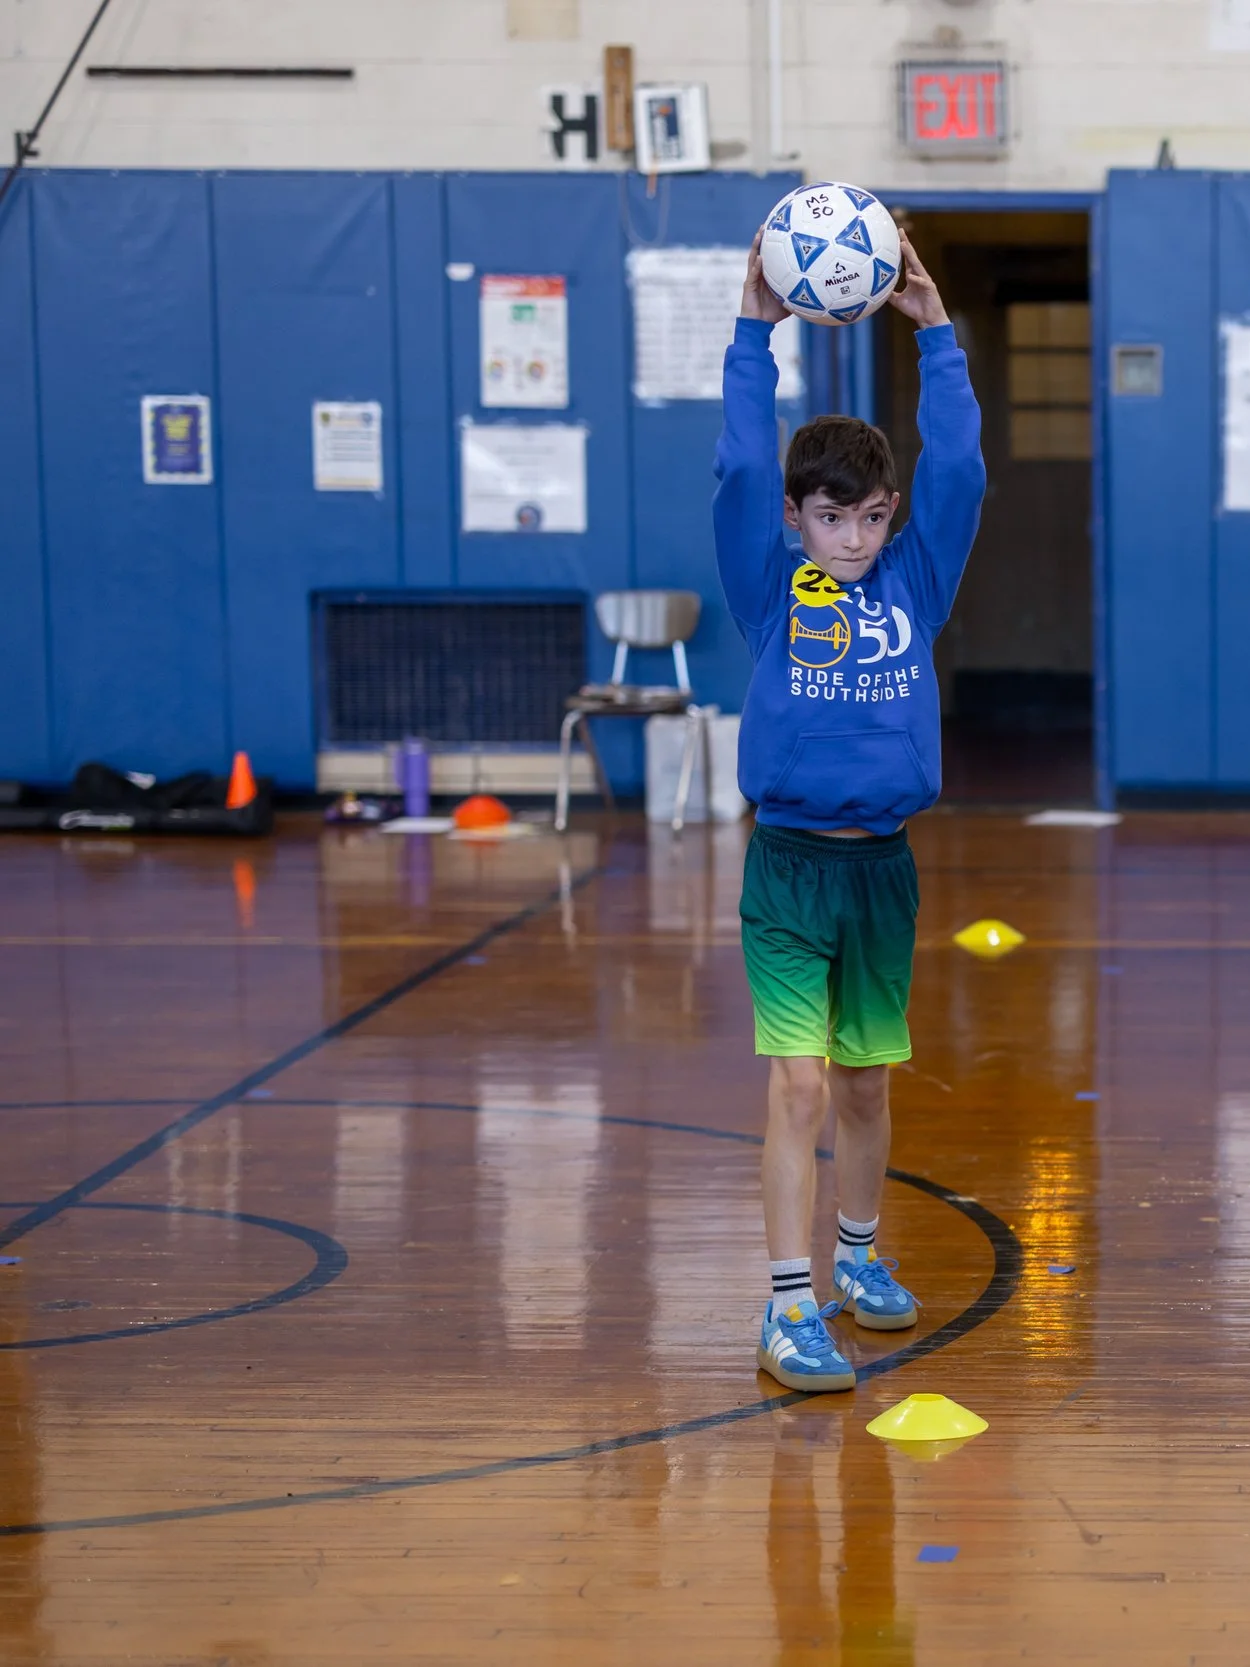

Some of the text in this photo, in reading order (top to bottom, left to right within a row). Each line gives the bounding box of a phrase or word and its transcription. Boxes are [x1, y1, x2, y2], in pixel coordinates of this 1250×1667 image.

[914, 73, 1003, 139] EXIT
[551, 94, 598, 160] H
[805, 193, 829, 208] MS
[812, 206, 834, 220] 50
[788, 665, 920, 687] RIDE OF THE
[790, 682, 910, 702] SOUTHSIDE
